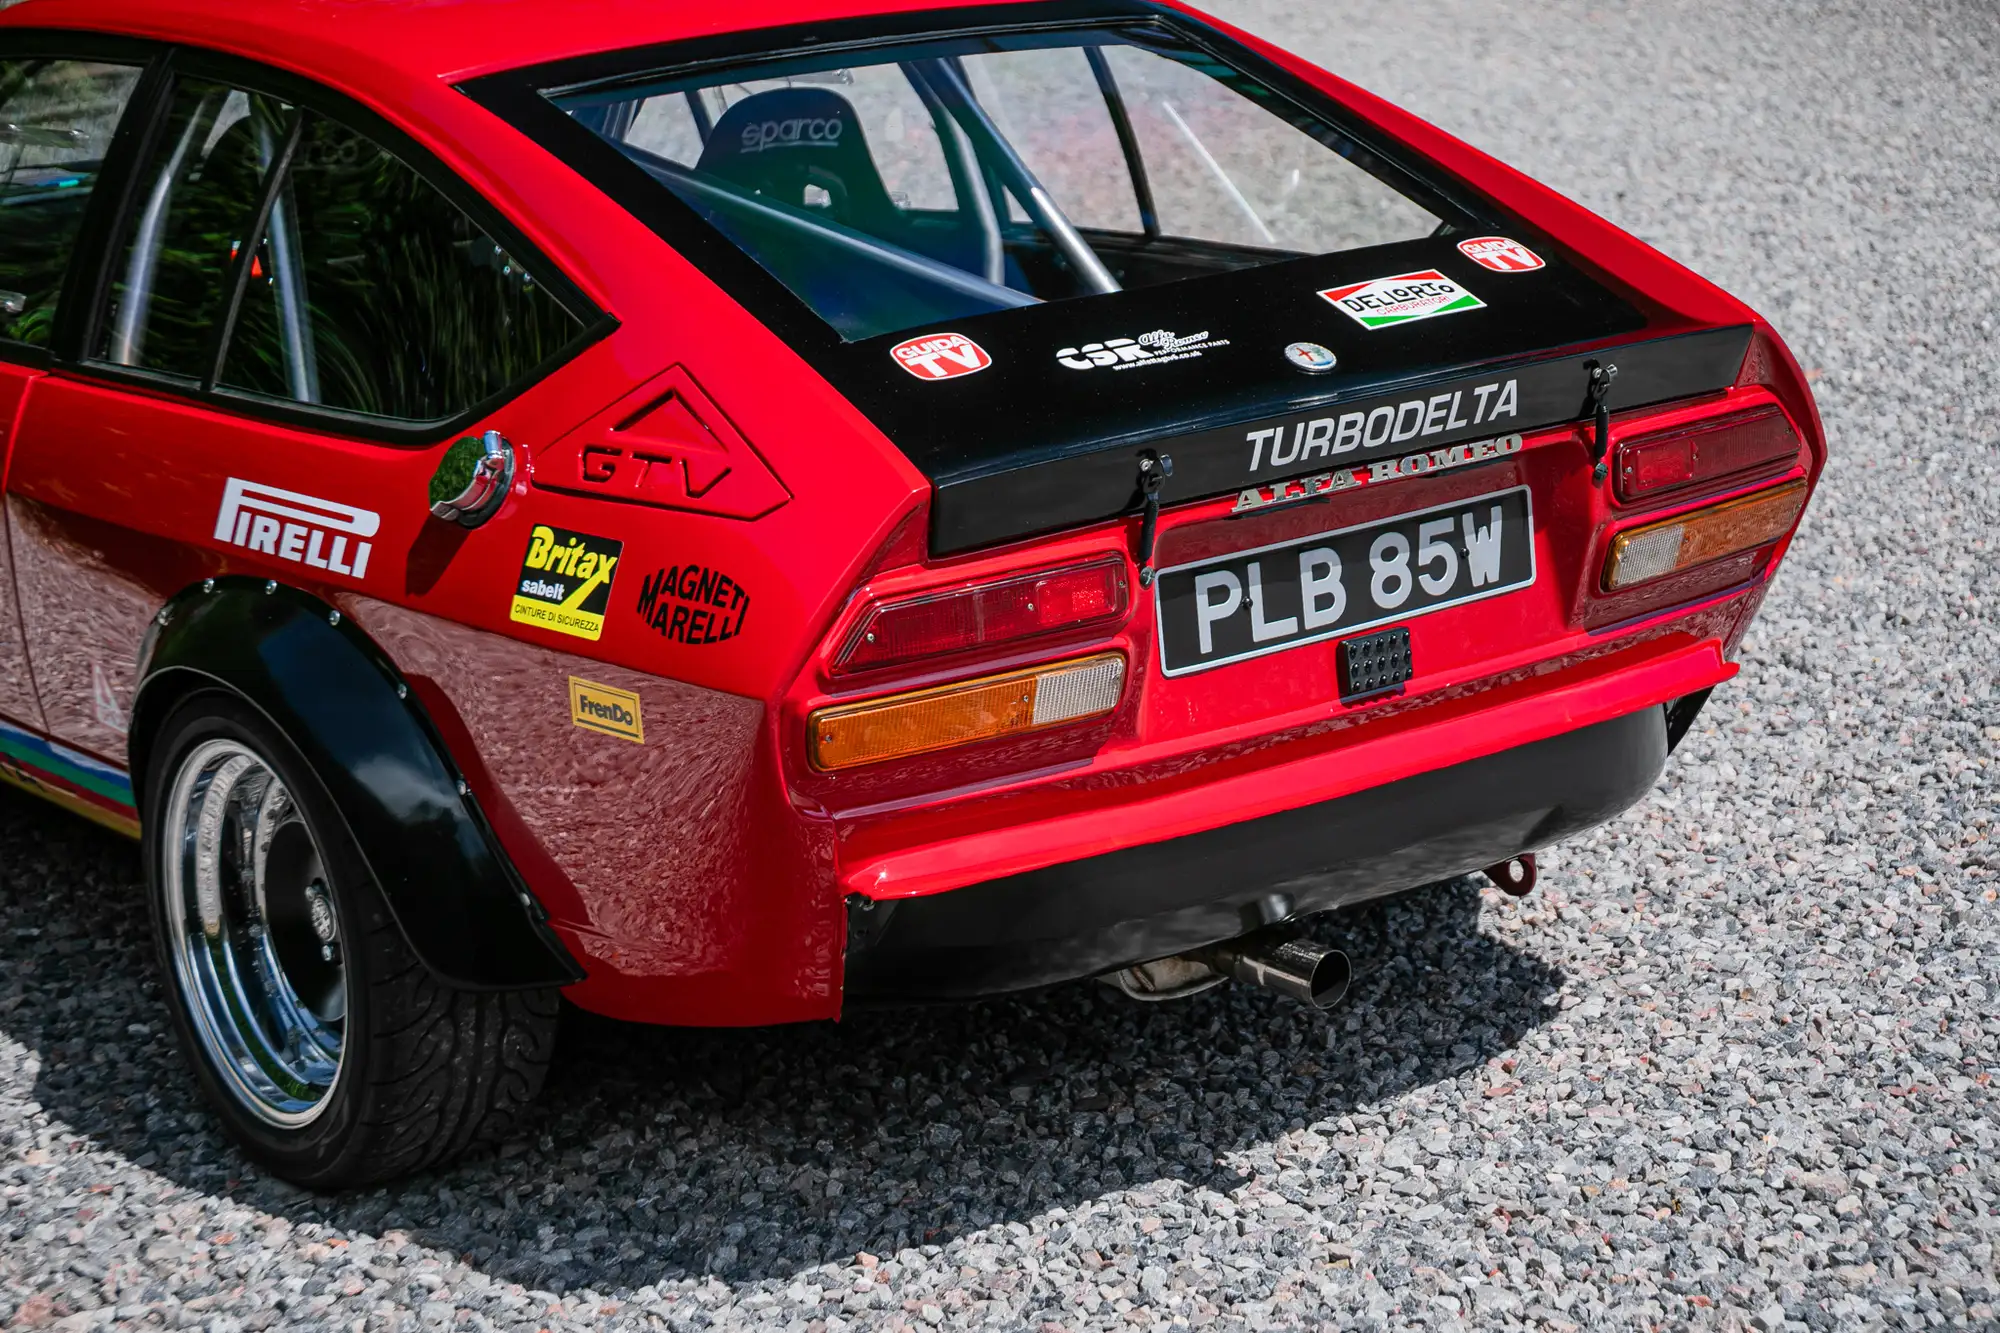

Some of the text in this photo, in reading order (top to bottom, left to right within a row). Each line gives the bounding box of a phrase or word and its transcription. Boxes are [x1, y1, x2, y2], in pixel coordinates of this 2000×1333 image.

[741, 118, 843, 152] sparco
[1462, 240, 1522, 254] GUIDA
[1472, 247, 1538, 270] TV
[1376, 296, 1452, 315] CARBURATORI
[896, 335, 970, 359] GUIDA
[1056, 338, 1154, 370] CSR
[1138, 329, 1209, 350] Alfa Romeo
[1208, 339, 1231, 348] PARTS
[904, 344, 982, 377] TV
[1246, 379, 1518, 472] TURBODELTA
[578, 444, 733, 500] GTV
[1231, 432, 1524, 513] ALFA ROMEO
[213, 476, 381, 580] PIRELLI
[525, 526, 618, 584] Britax
[521, 579, 565, 601] sabelt
[637, 564, 751, 618] MAGNETI
[1195, 505, 1502, 654] PLB 85W
[515, 604, 599, 633] CINTURE DI SICUREZZA
[637, 597, 750, 645] MARELLI
[580, 694, 633, 726] FrenDo
